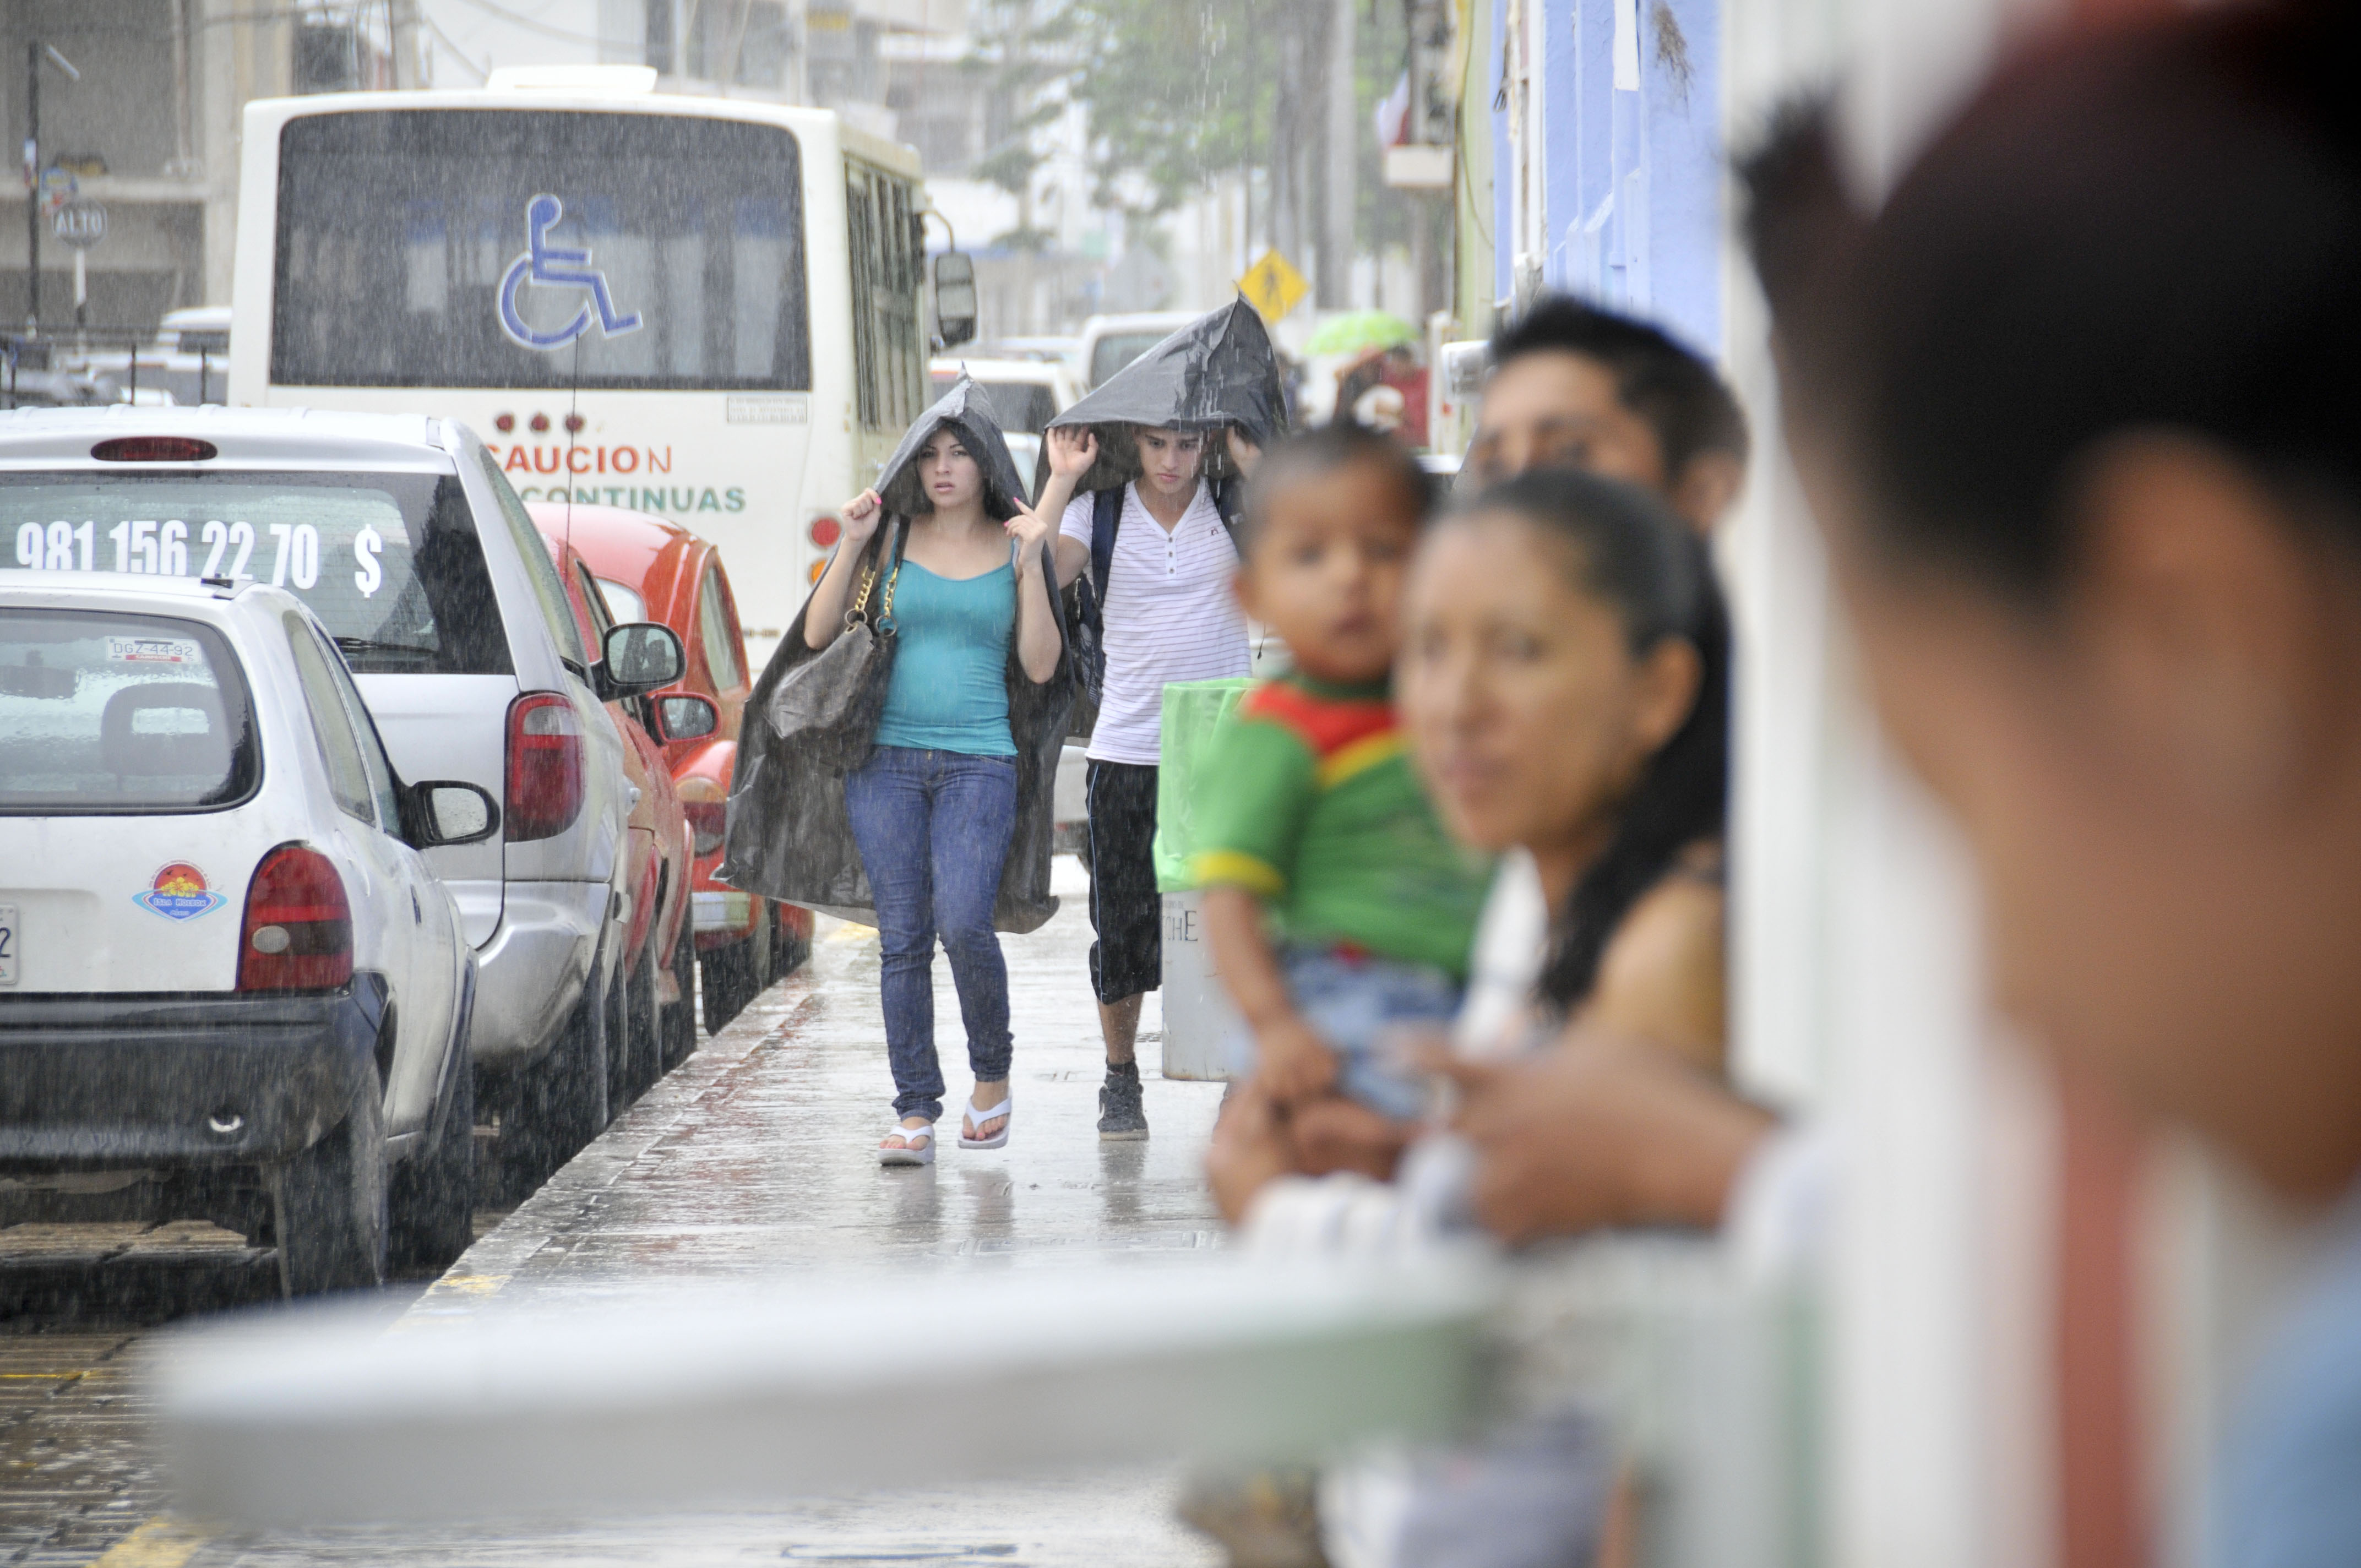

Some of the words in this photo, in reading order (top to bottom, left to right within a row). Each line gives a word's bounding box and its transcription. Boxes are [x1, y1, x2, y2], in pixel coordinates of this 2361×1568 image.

[56, 209, 102, 235] ALTO
[487, 444, 672, 474] AUCION
[521, 487, 746, 513] CONTINUAS
[17, 521, 93, 570] 981
[110, 520, 188, 576] 156
[202, 520, 254, 580] 22
[270, 524, 318, 589] 70
[355, 524, 382, 597] $
[113, 643, 193, 656] DGZ-44-92
